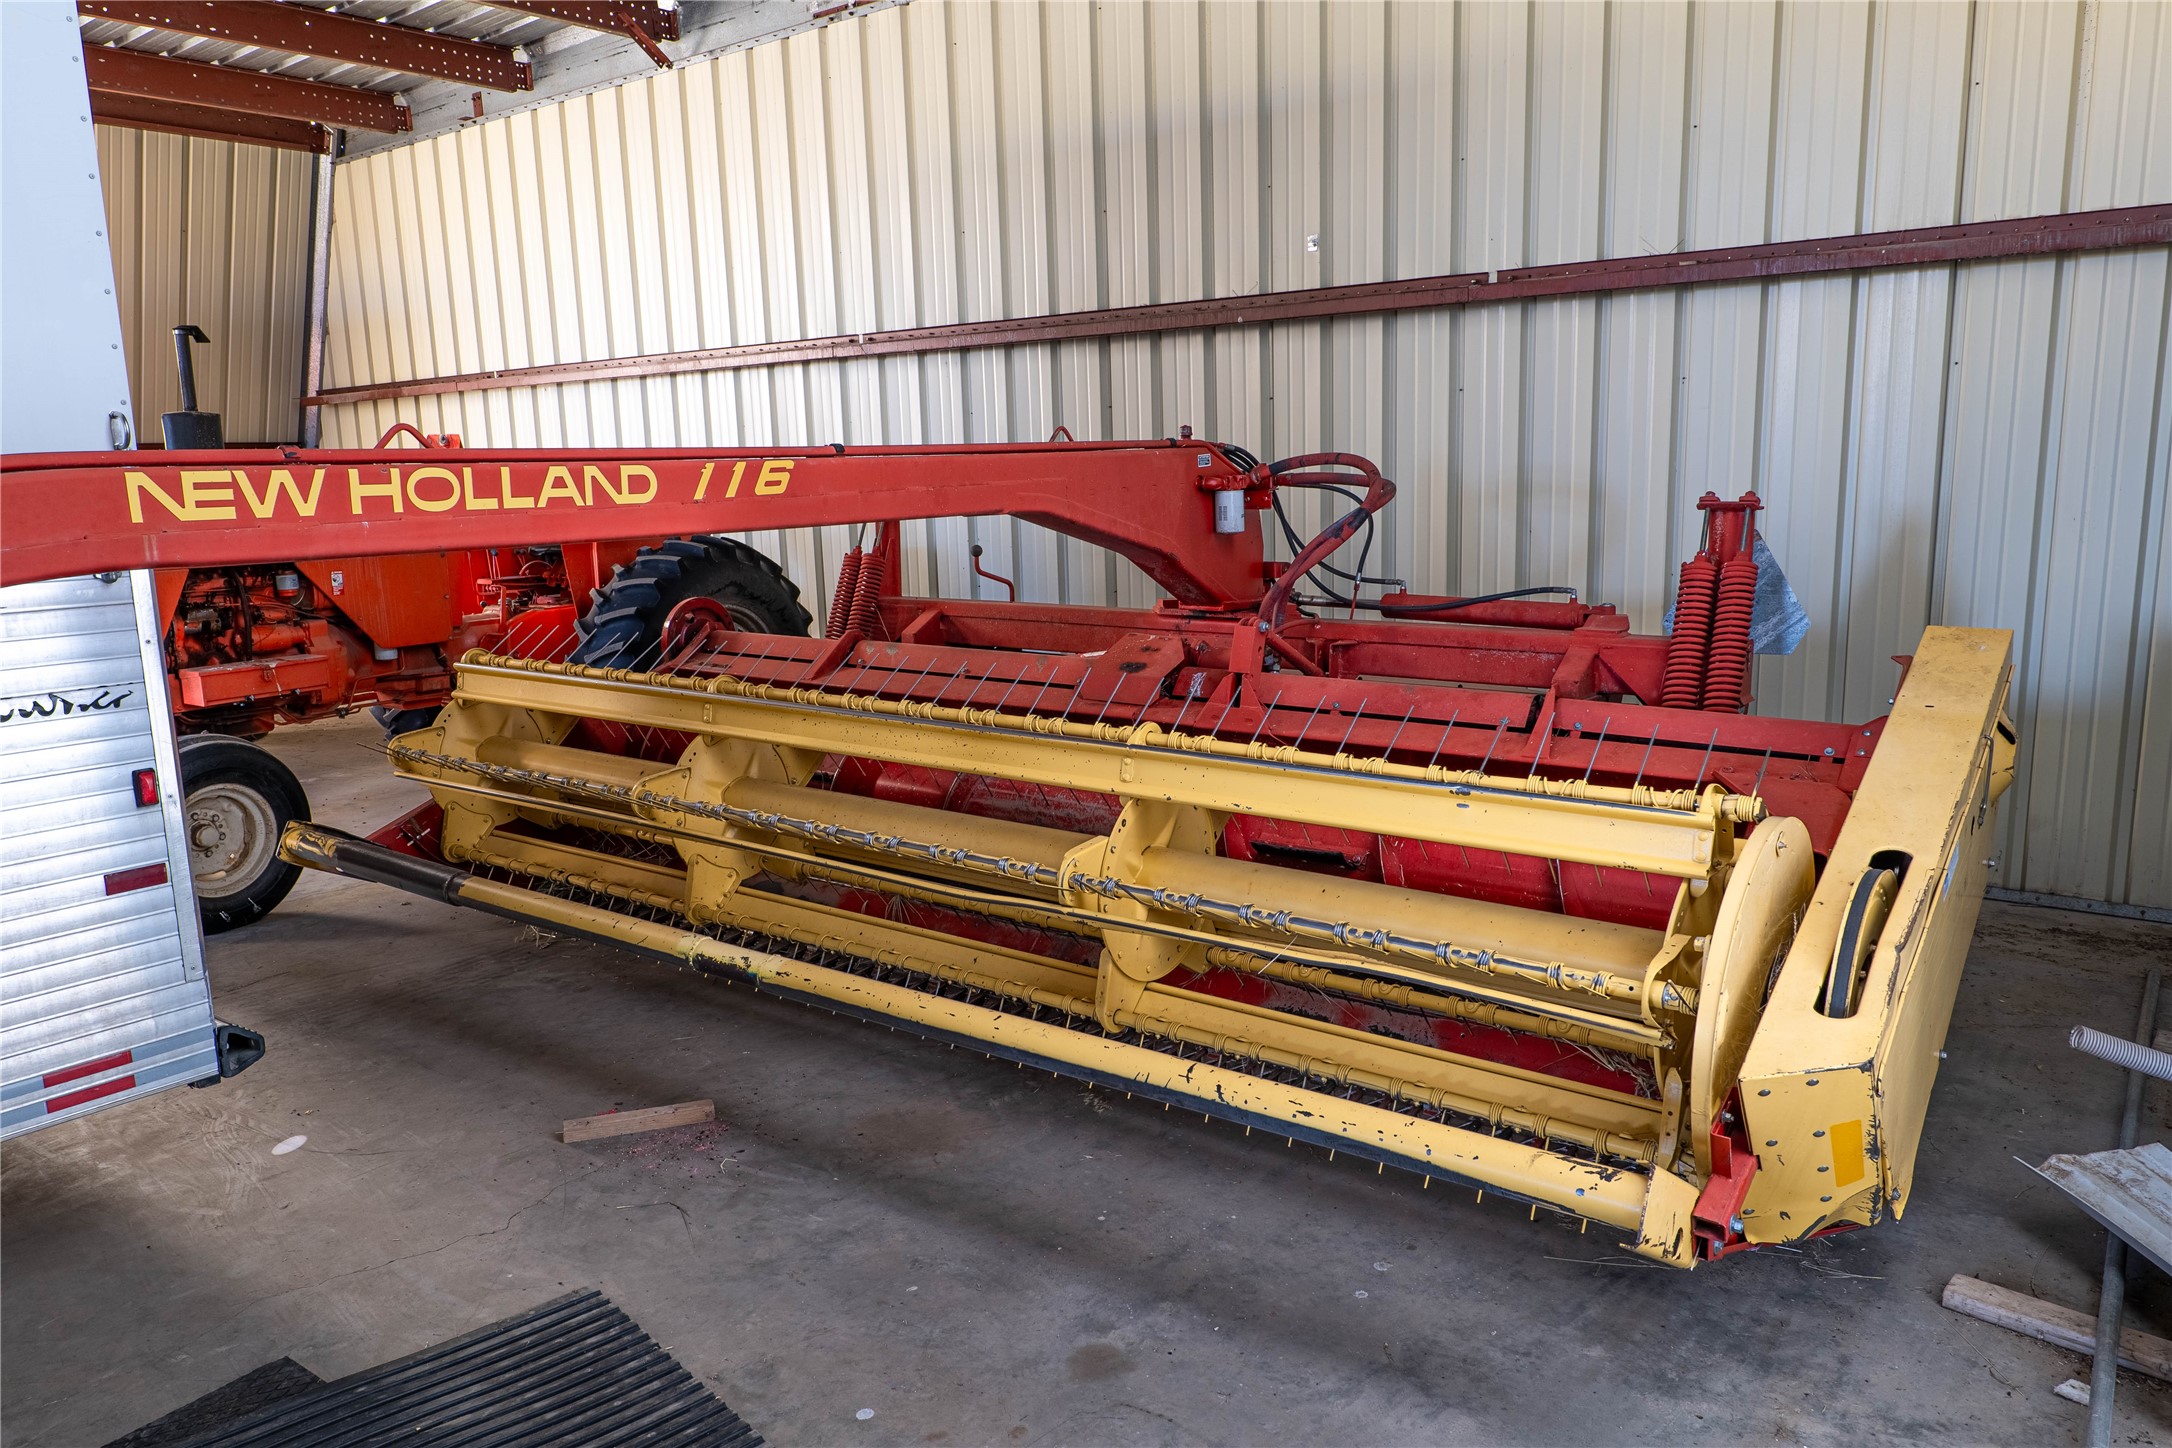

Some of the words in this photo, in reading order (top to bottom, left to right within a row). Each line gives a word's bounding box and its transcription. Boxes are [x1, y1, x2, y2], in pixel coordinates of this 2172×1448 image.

[124, 468, 326, 523] NEW
[347, 465, 658, 514] HOLLAND
[693, 460, 795, 500] 116
